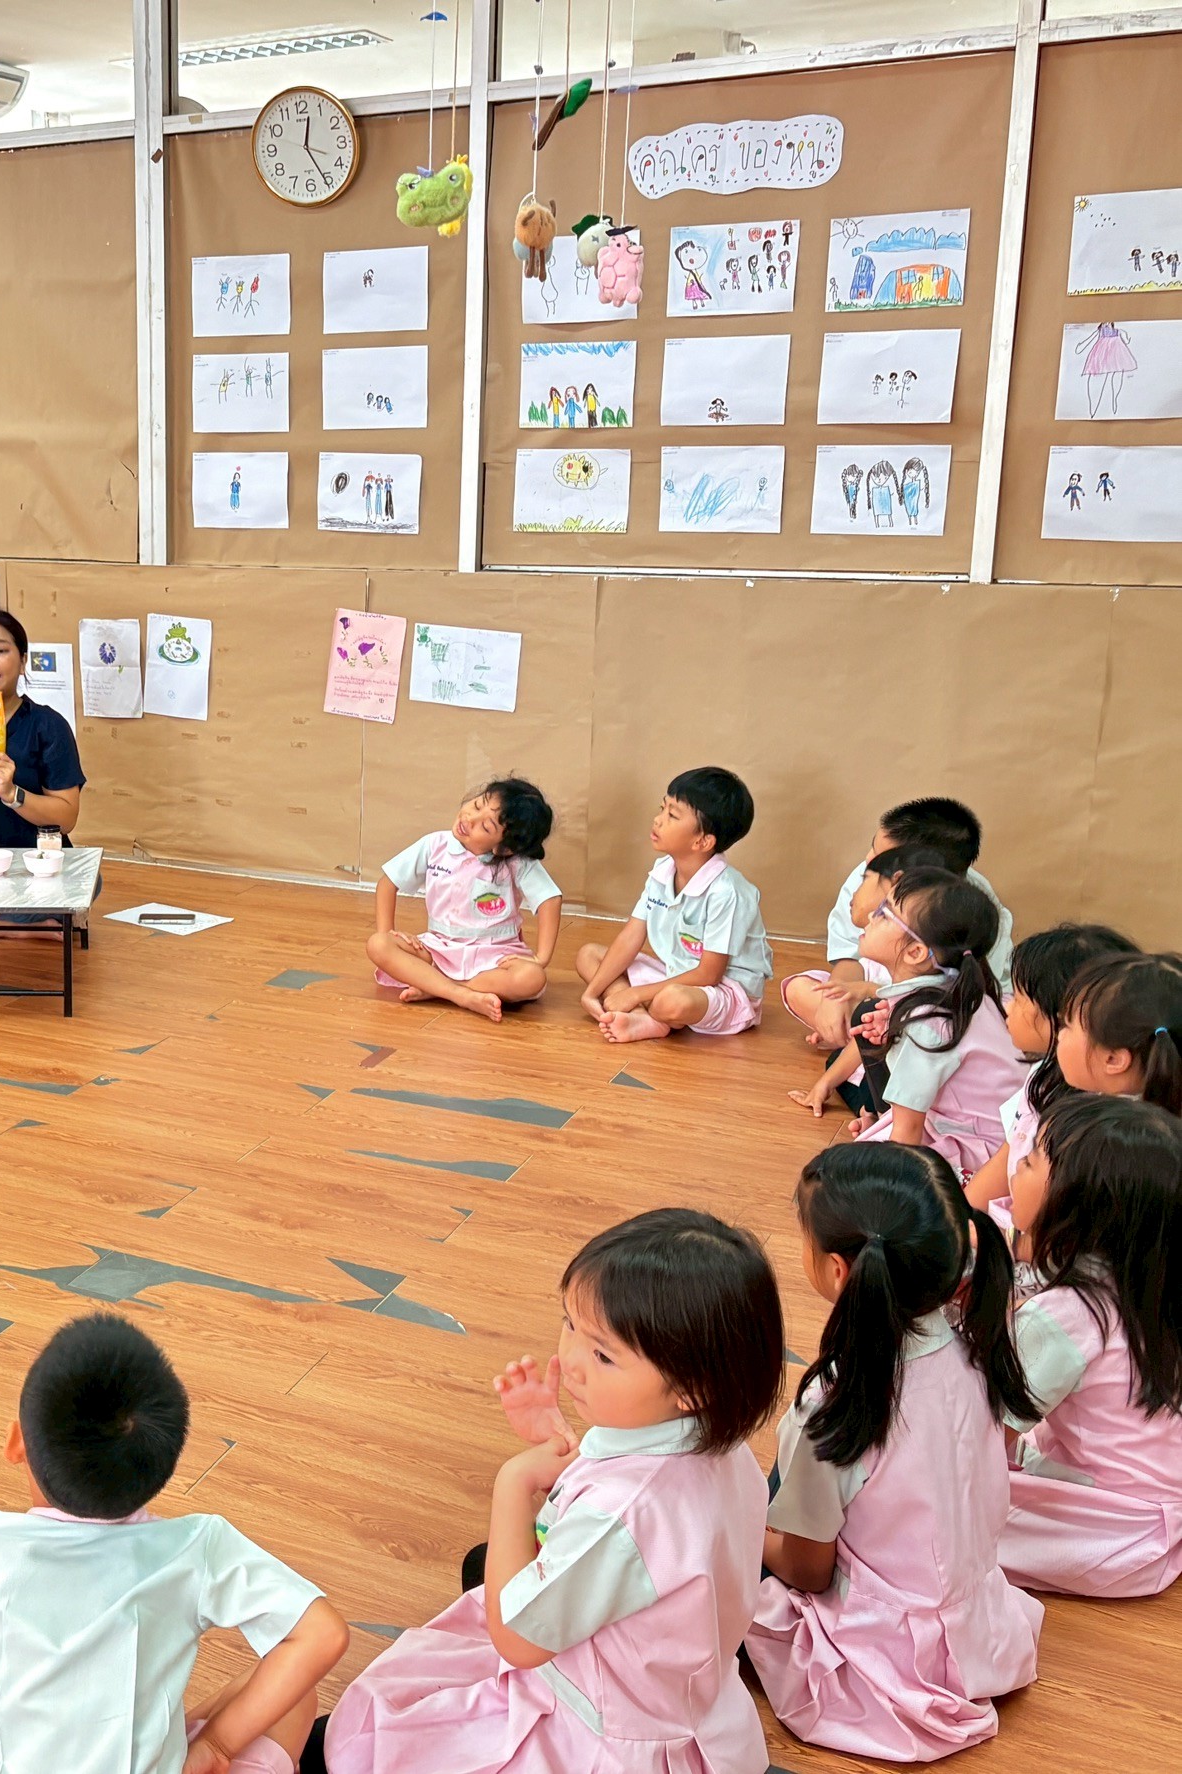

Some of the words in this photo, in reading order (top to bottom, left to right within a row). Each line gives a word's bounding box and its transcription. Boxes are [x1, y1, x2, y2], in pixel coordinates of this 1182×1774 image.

[279, 107, 290, 121] 11
[294, 100, 309, 115] 12
[316, 102, 322, 116] 1
[330, 116, 340, 130] 2
[270, 123, 283, 138] 10
[336, 135, 347, 149] 3
[267, 144, 277, 158] 9
[274, 162, 285, 176] 8
[334, 156, 344, 170] 4
[639, 144, 721, 192] คุณครู
[739, 138, 825, 179] ของหนู
[289, 175, 299, 189] 7
[305, 178, 317, 193] 6
[323, 172, 334, 186] 5
